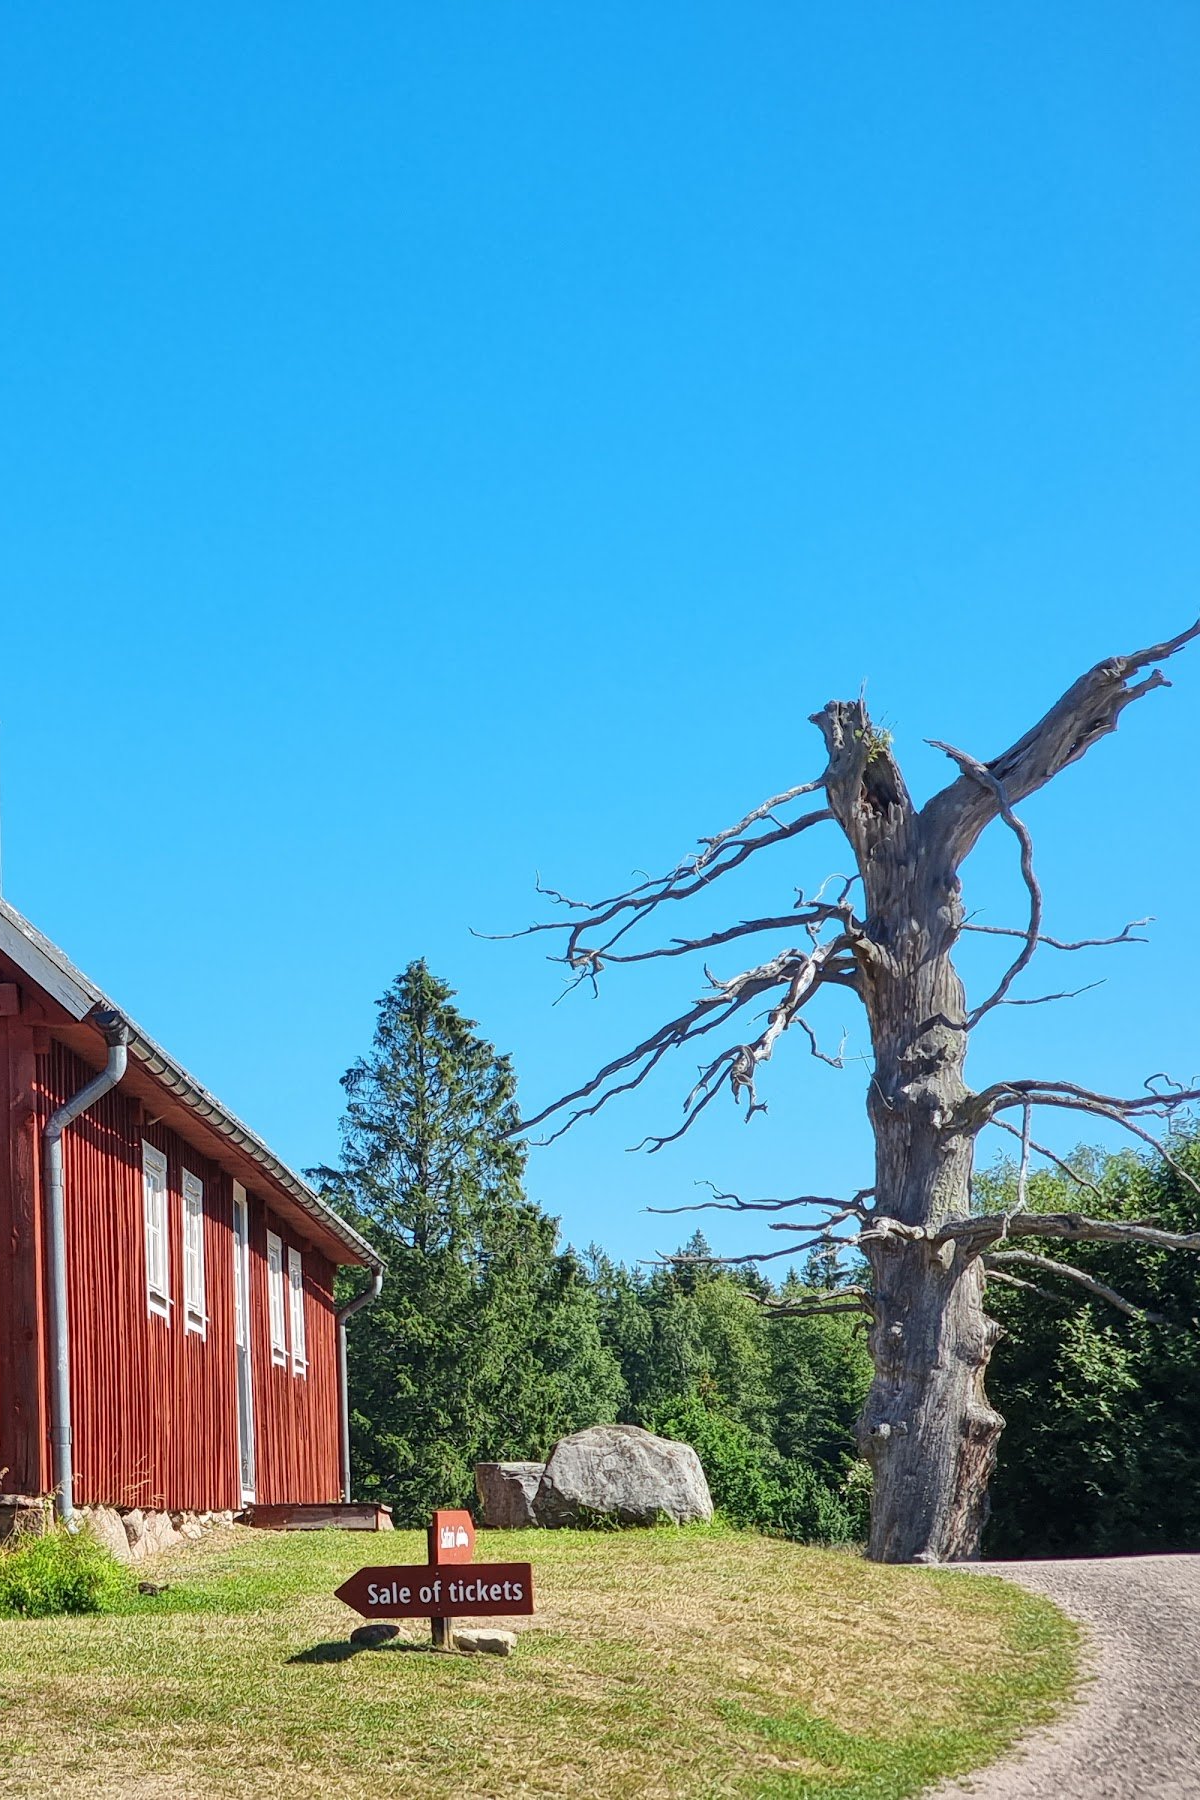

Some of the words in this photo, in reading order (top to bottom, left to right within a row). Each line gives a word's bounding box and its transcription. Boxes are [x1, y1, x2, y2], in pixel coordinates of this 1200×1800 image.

[367, 1581, 411, 1605] Sale
[420, 1580, 441, 1603] of
[449, 1579, 523, 1603] tickets
